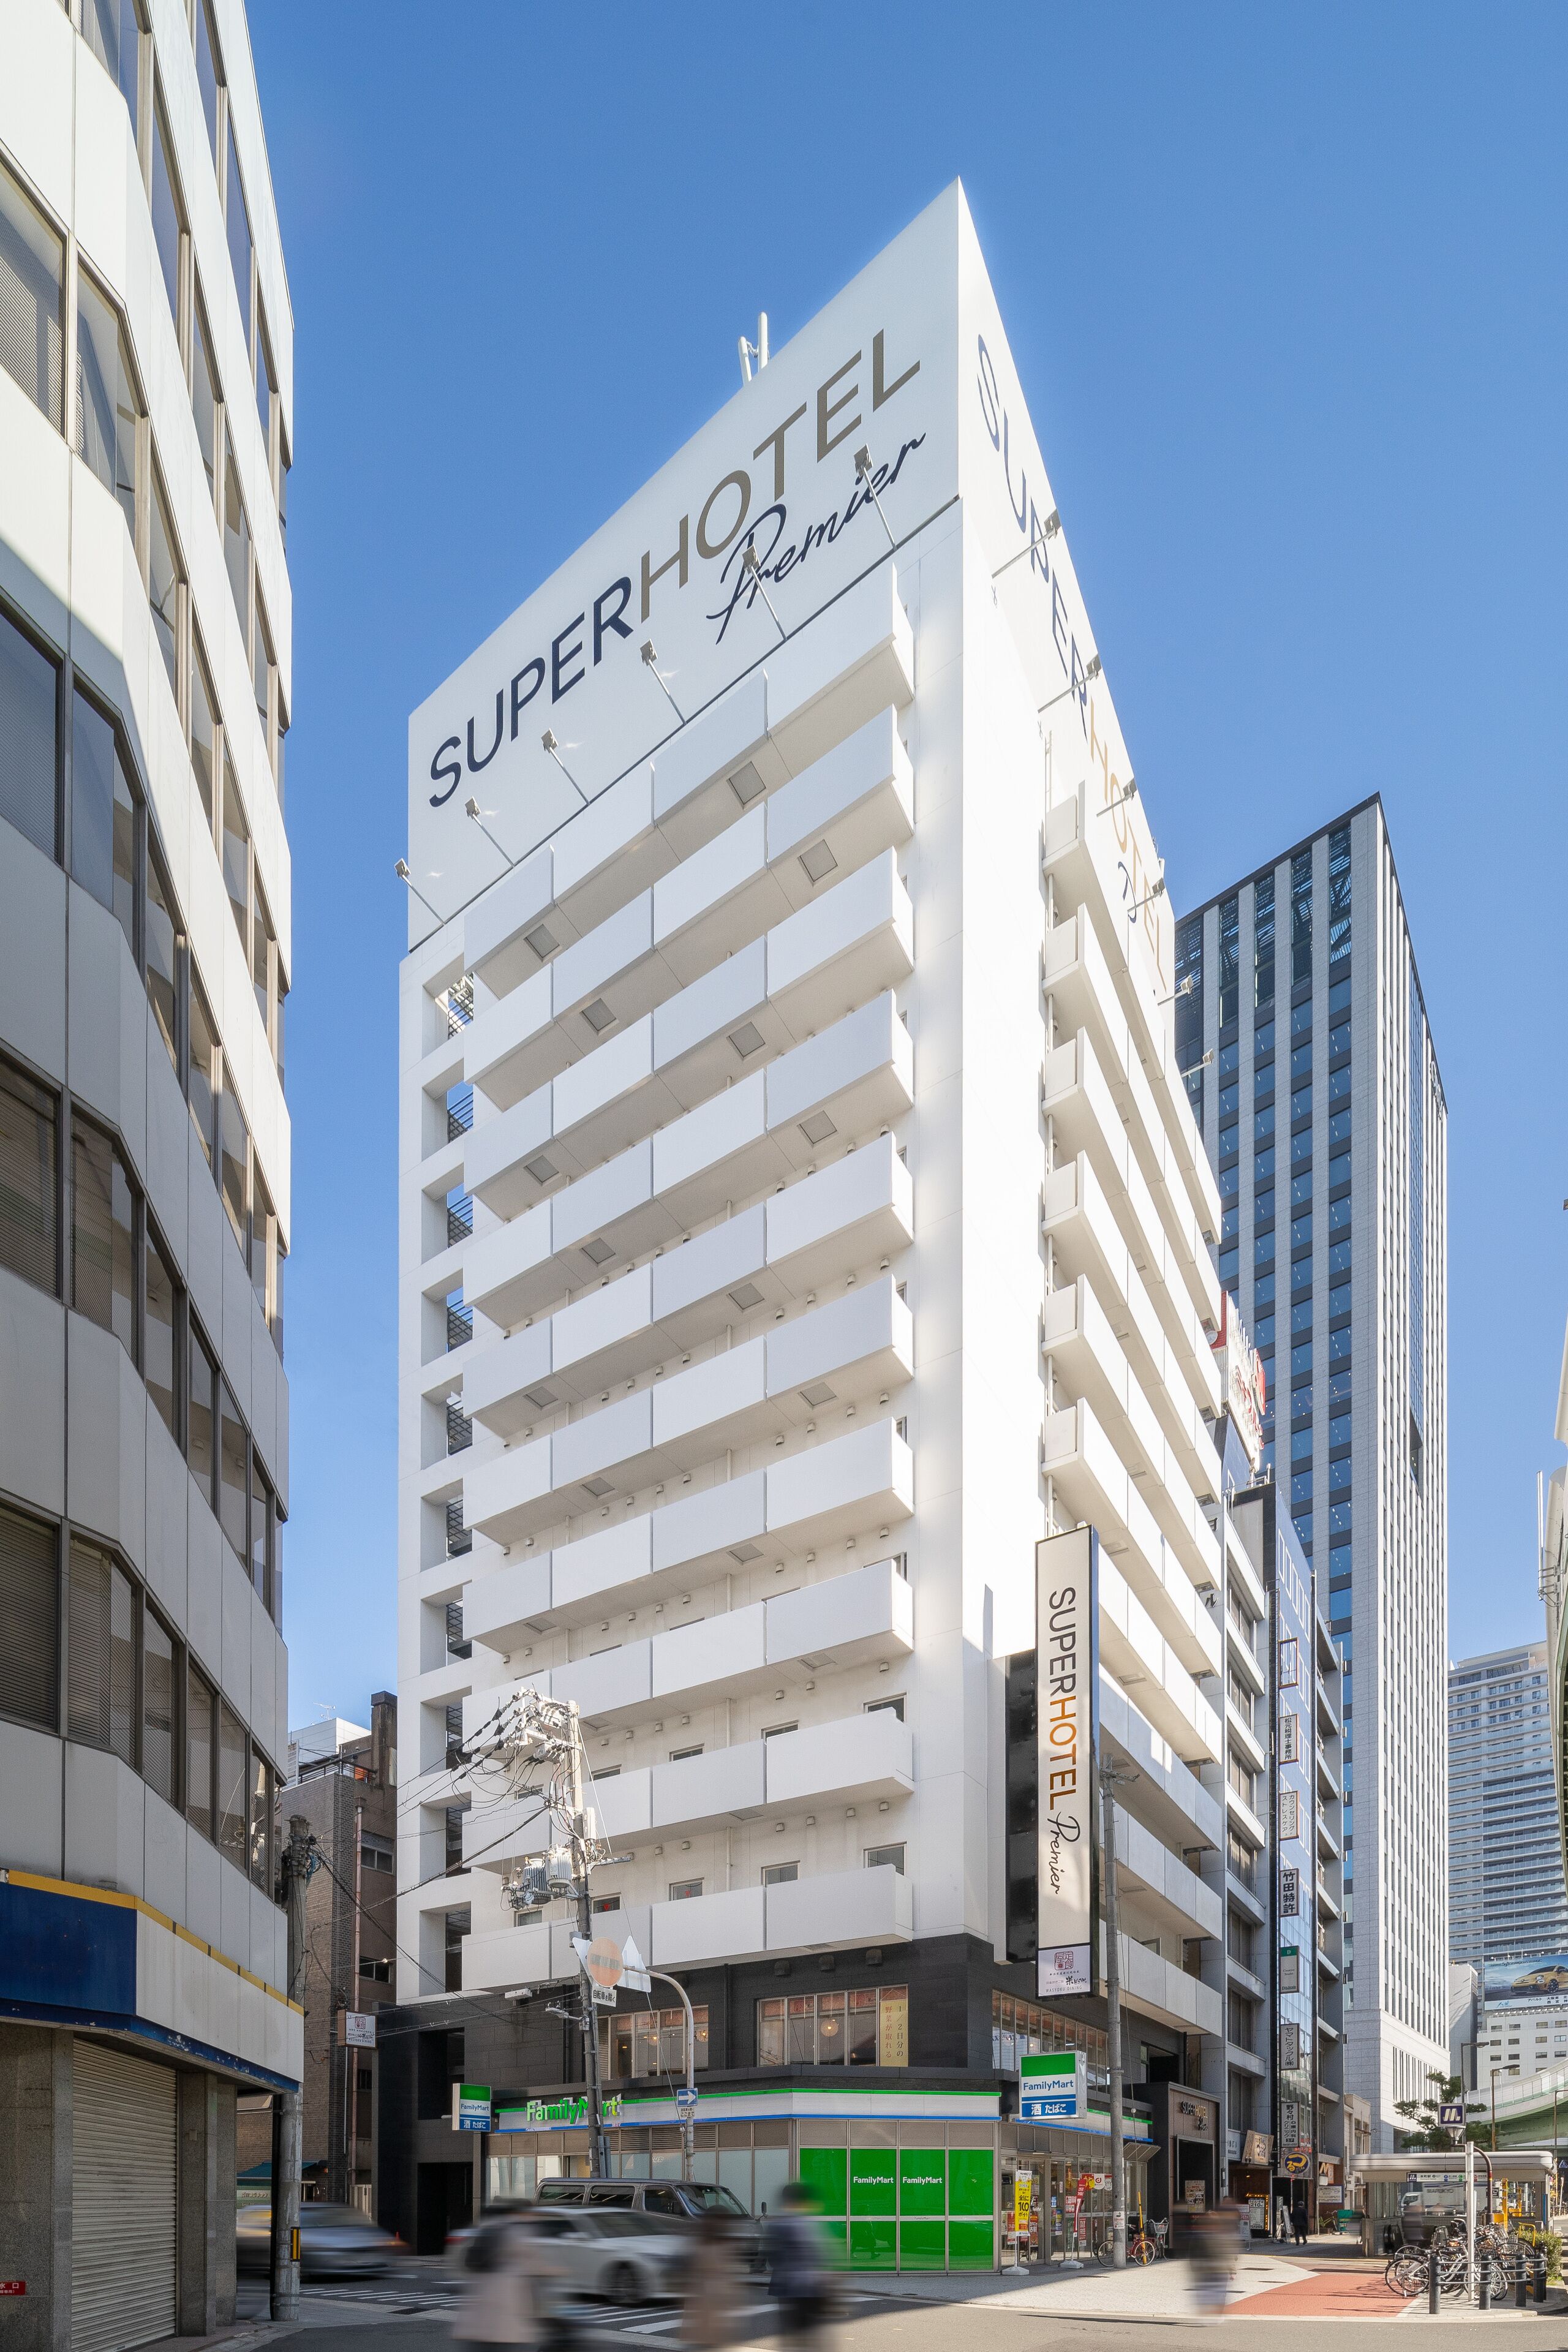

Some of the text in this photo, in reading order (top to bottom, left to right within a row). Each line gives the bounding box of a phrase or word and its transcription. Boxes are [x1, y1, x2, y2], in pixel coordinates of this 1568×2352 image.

[705, 432, 926, 644] Premier
[429, 329, 921, 808] SUPERHOTEL
[1047, 1586, 1080, 1894] SUPERHOTEL Premier
[1283, 1872, 1295, 1913] 竹田特許
[593, 1989, 615, 2002] 自転車を除く
[1023, 2080, 1074, 2091] FamilyMart
[527, 2096, 617, 2124] FamilyMrt
[1031, 2103, 1067, 2116] 酒 たばこ
[464, 2120, 471, 2129] 酒
[853, 2176, 894, 2185] FamilyMart
[902, 2176, 943, 2185] FamilyMart
